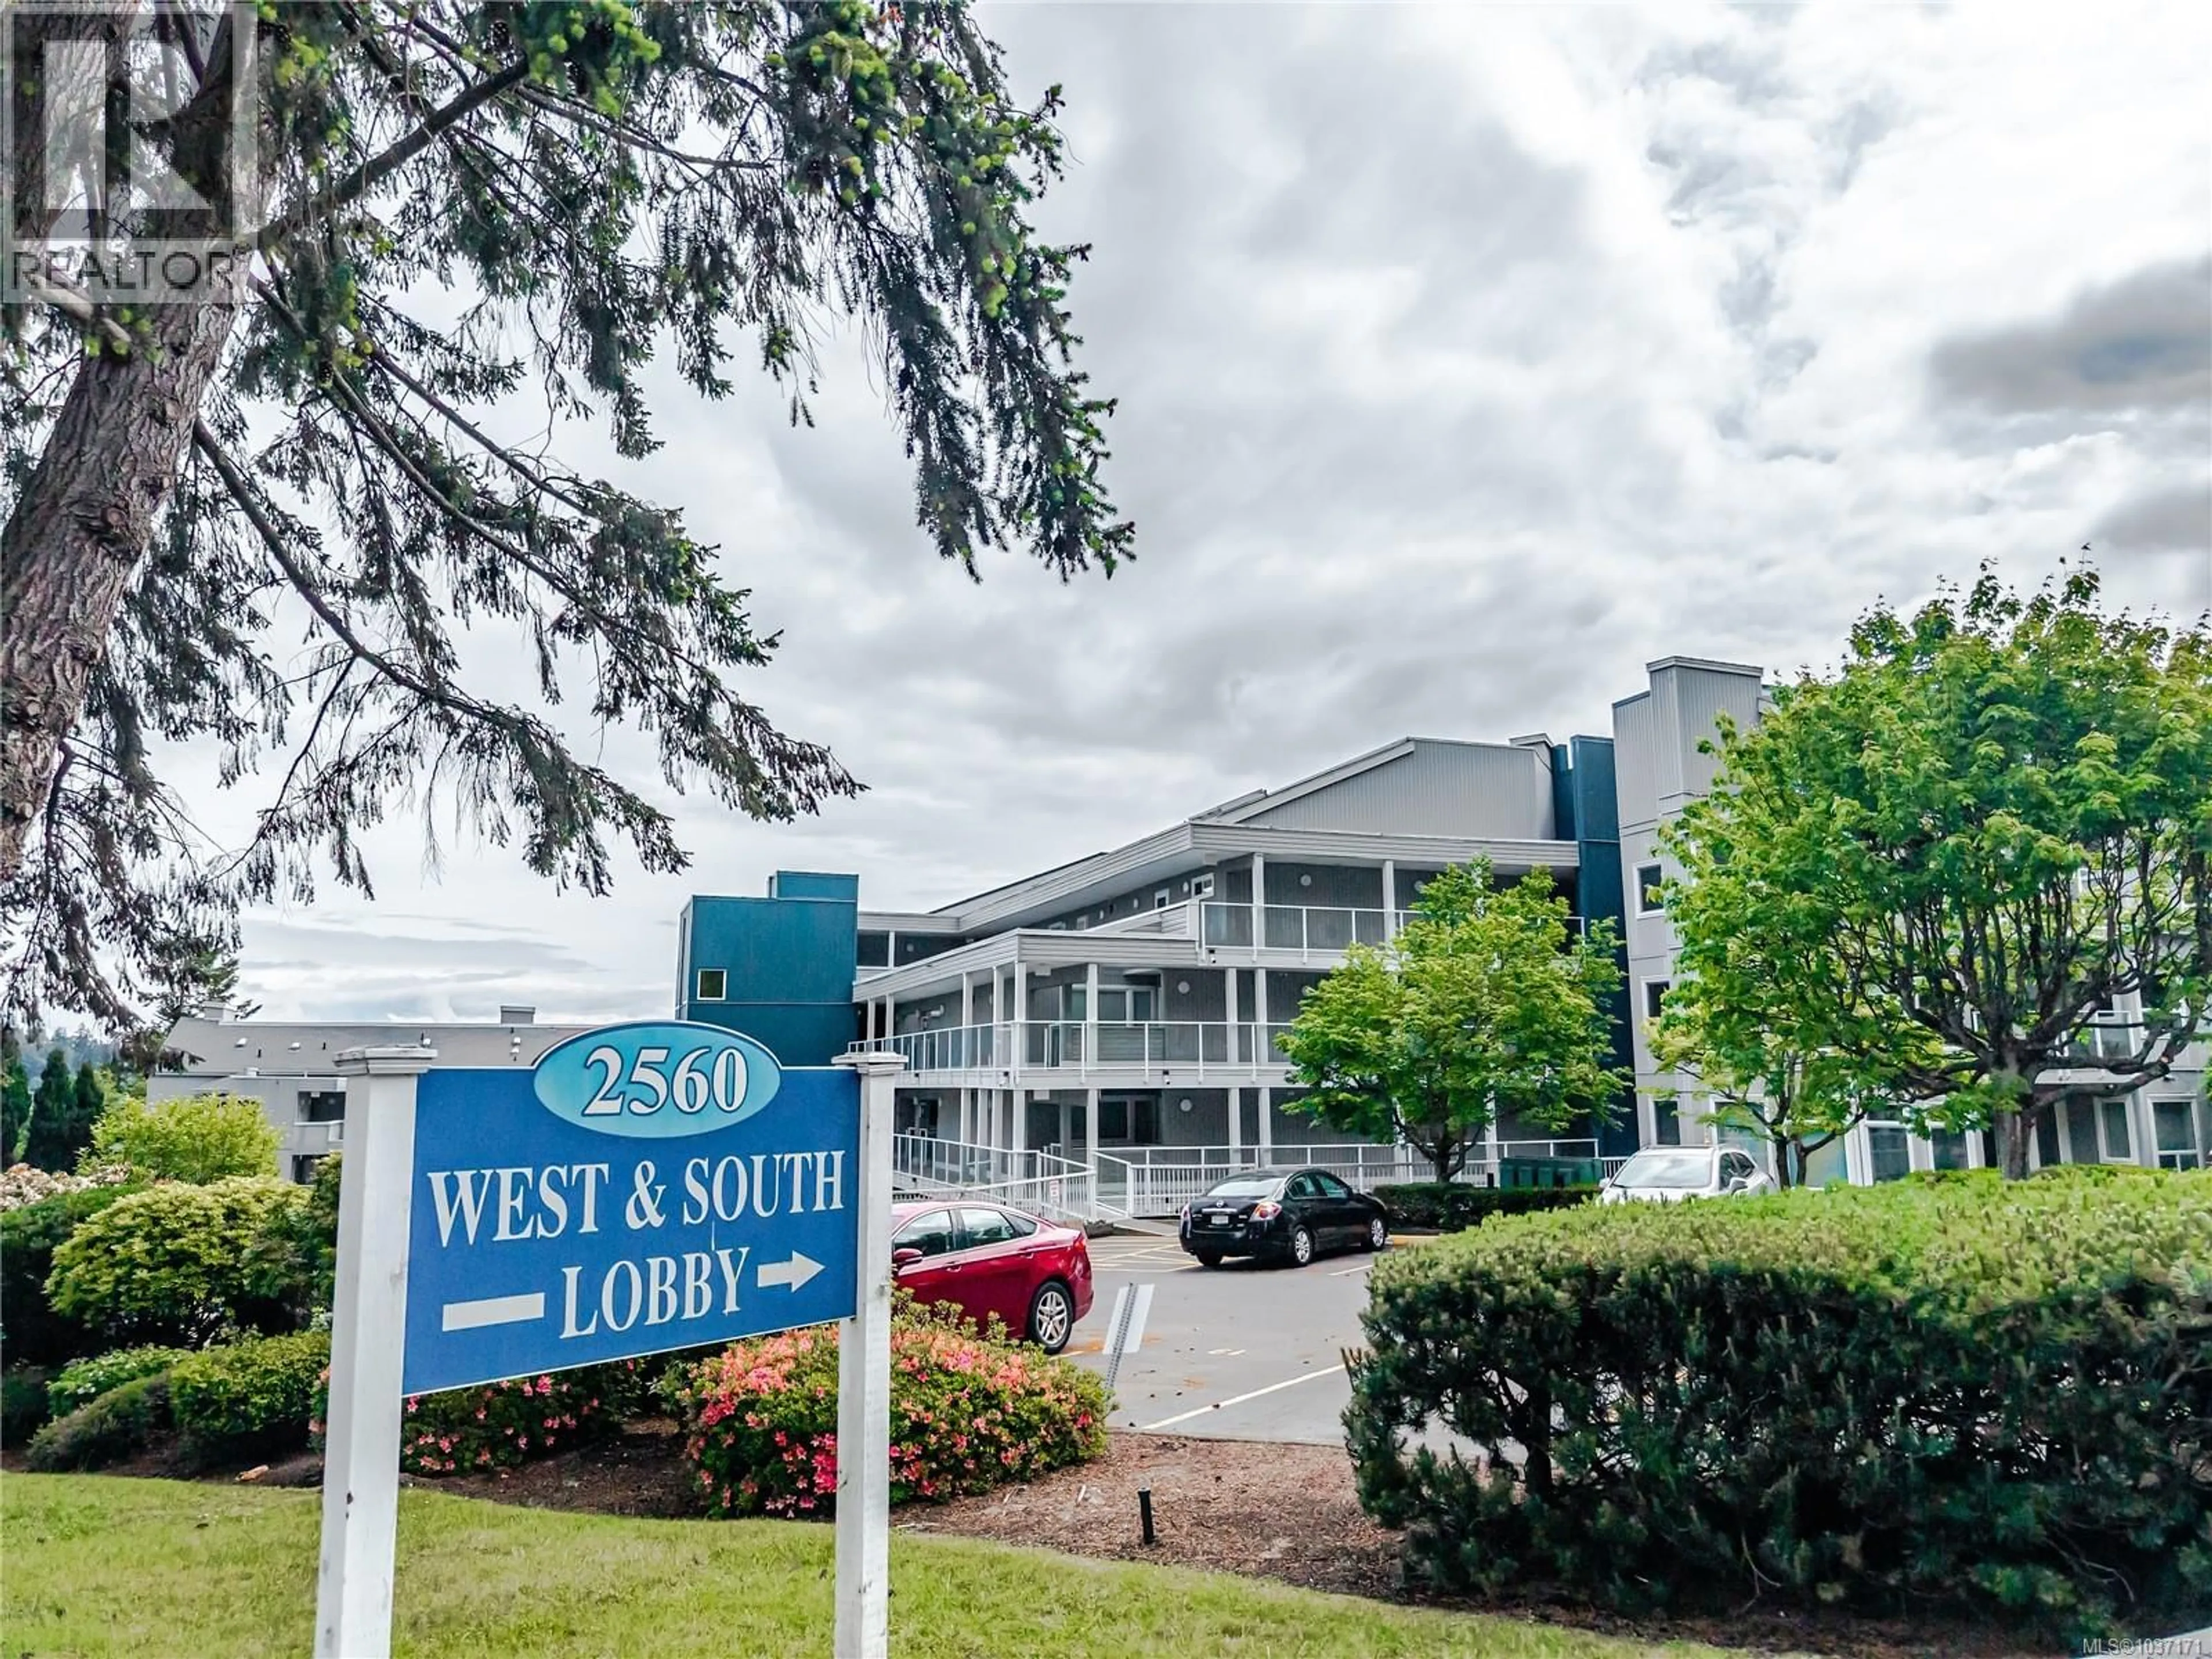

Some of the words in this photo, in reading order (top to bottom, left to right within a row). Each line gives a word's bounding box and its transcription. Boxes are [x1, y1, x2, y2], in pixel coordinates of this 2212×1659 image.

[582, 1046, 749, 1118] 2560
[427, 1162, 609, 1248] WEST
[625, 1160, 666, 1231] &
[683, 1150, 846, 1225] SOUTH
[559, 1247, 751, 1340] LOBBY
